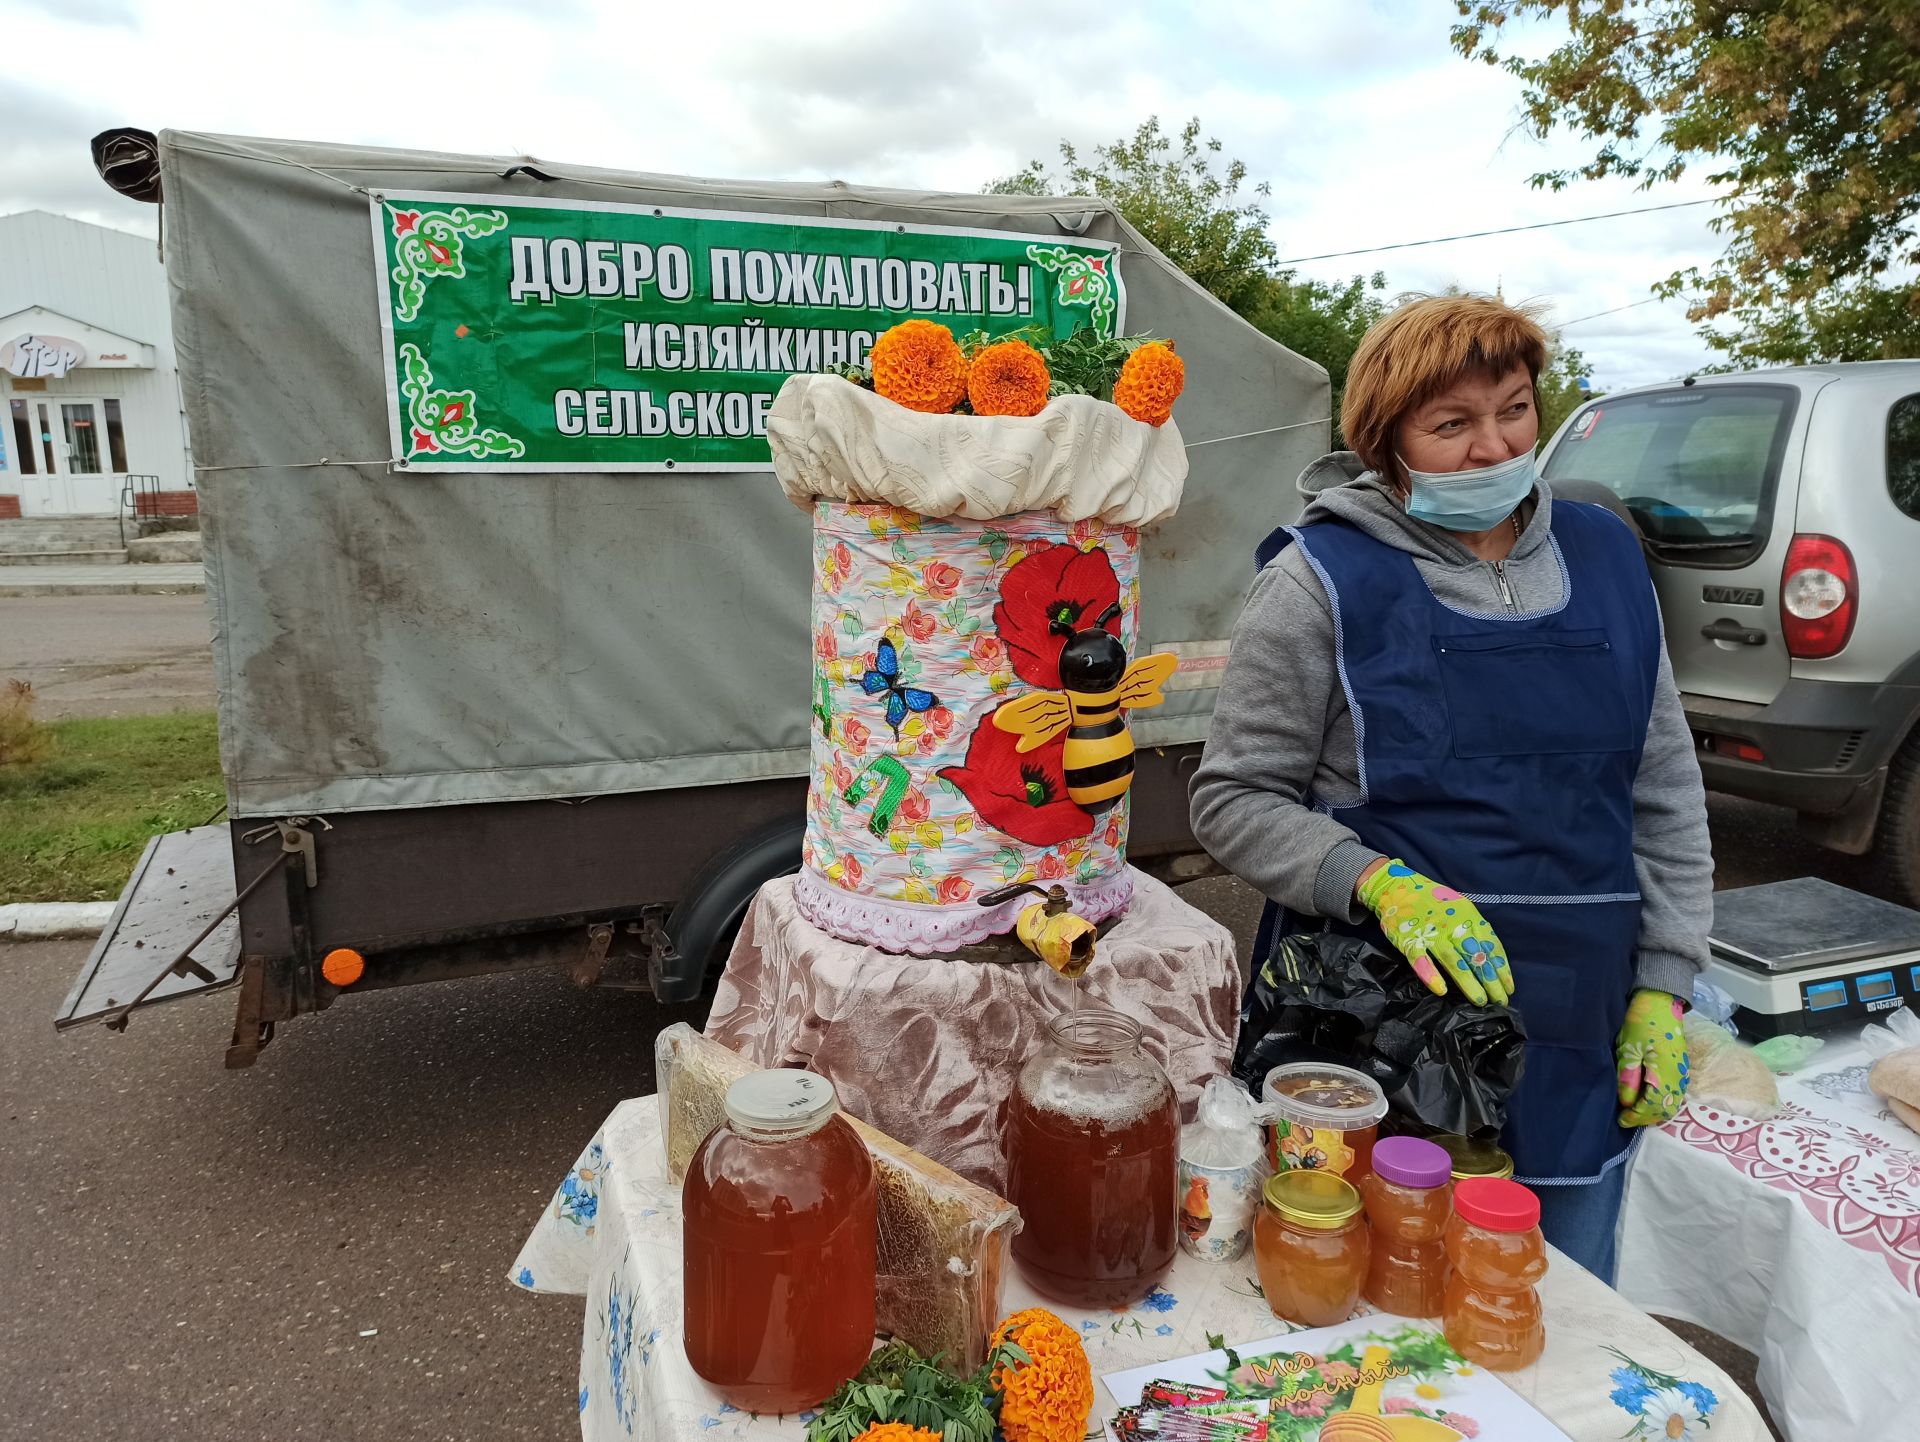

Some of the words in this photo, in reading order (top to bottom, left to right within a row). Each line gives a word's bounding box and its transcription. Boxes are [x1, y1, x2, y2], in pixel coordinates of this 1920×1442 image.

[510, 236, 692, 305] ДОБРО
[708, 248, 1033, 315] ПОЖАЛОВАТЬ!
[555, 388, 774, 438] СЕЛЬСКОЕ
[1251, 1351, 1316, 1383] Мед
